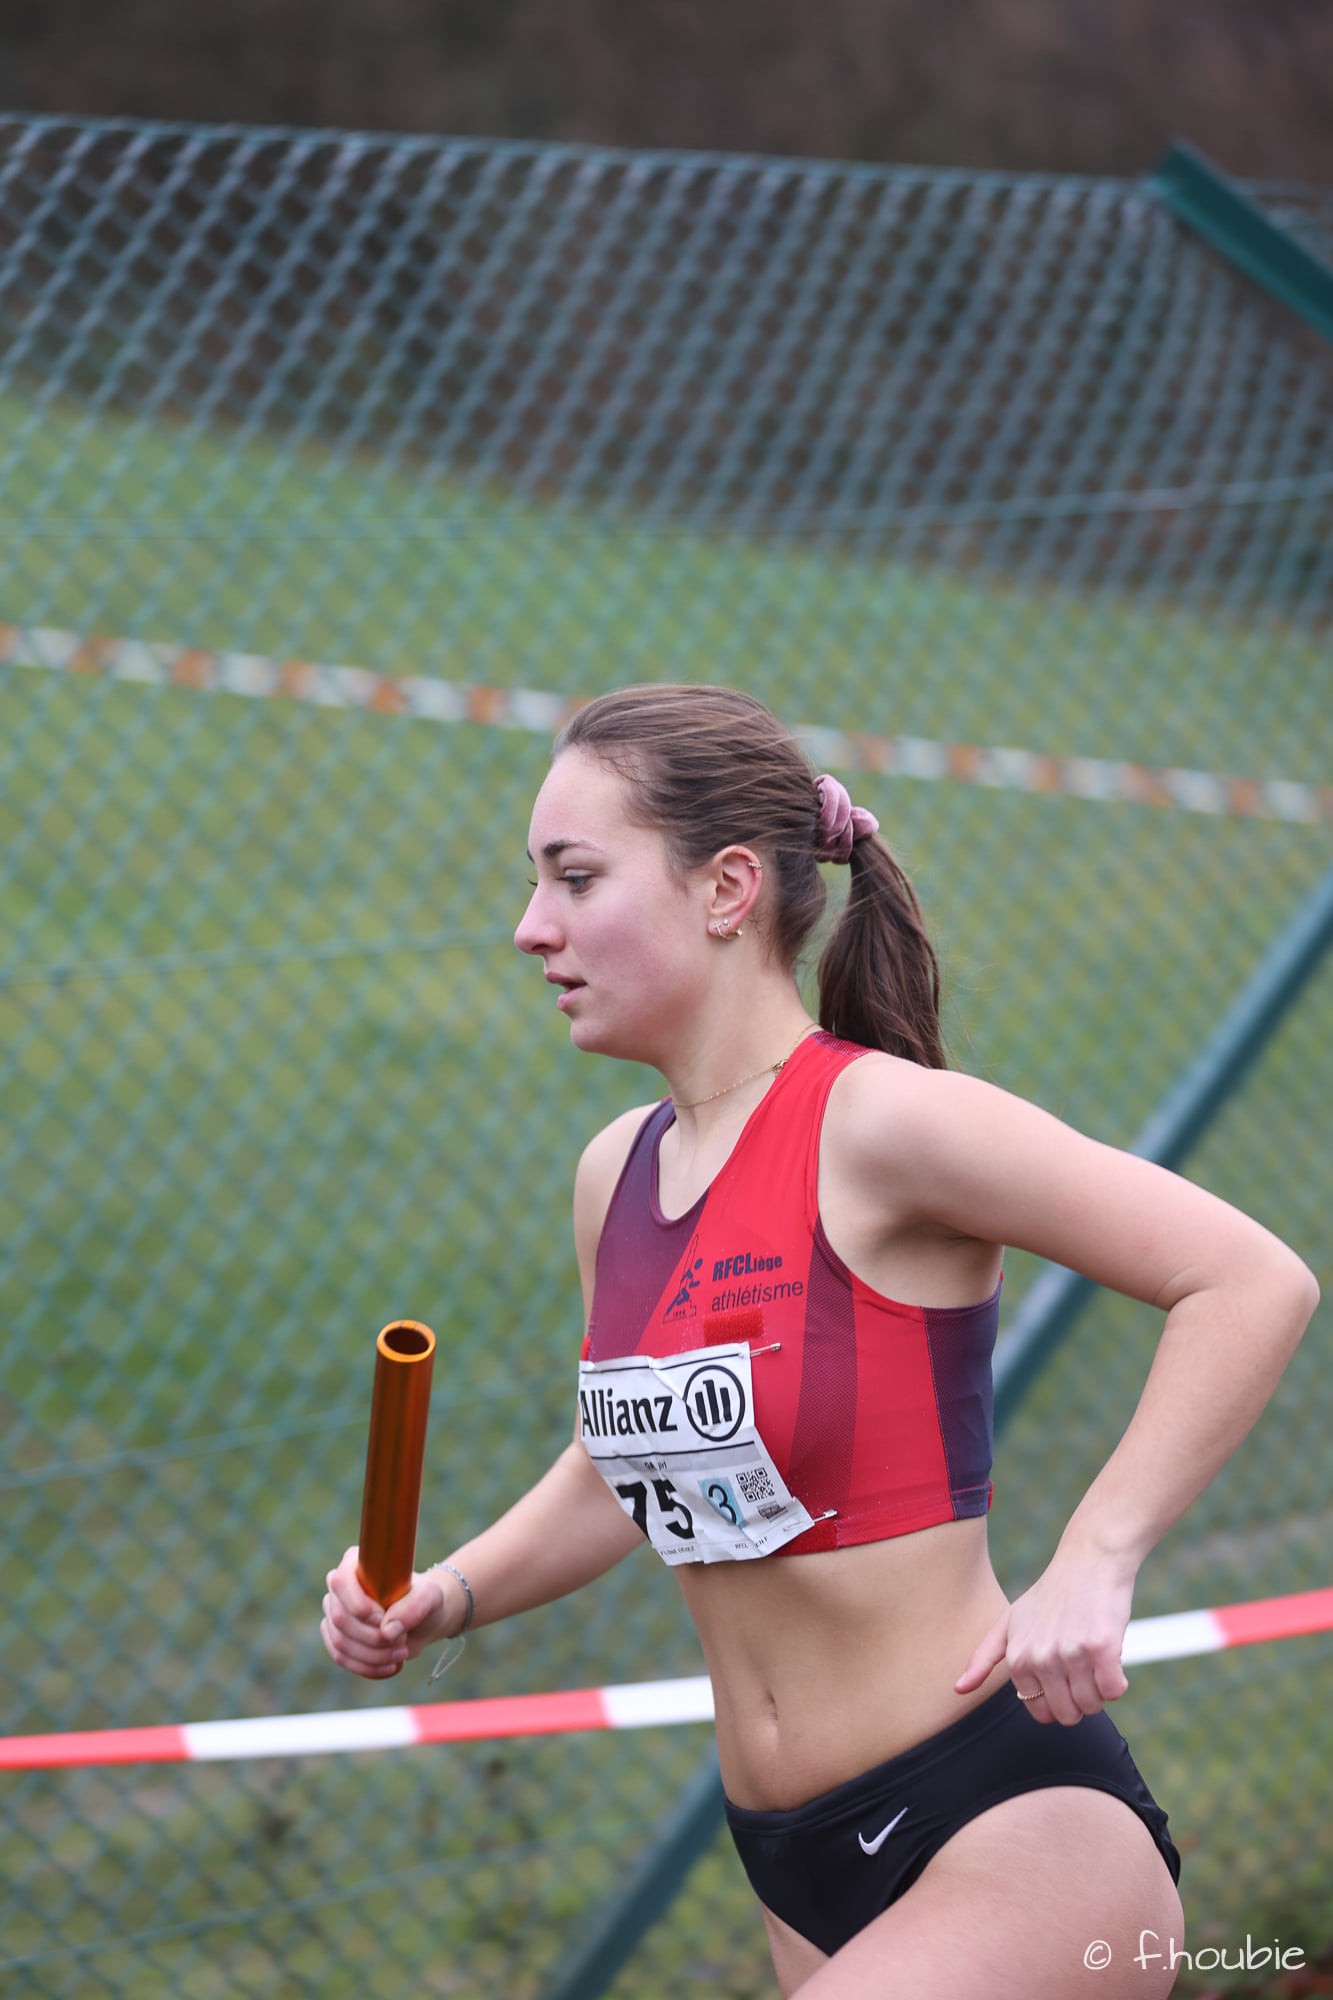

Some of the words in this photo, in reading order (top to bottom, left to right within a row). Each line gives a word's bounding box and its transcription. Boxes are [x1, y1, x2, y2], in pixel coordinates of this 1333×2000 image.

[711, 1281, 804, 1312] athlétisme
[579, 1387, 679, 1437] Allianz
[614, 1478, 696, 1544] 75
[707, 1484, 738, 1526] 3
